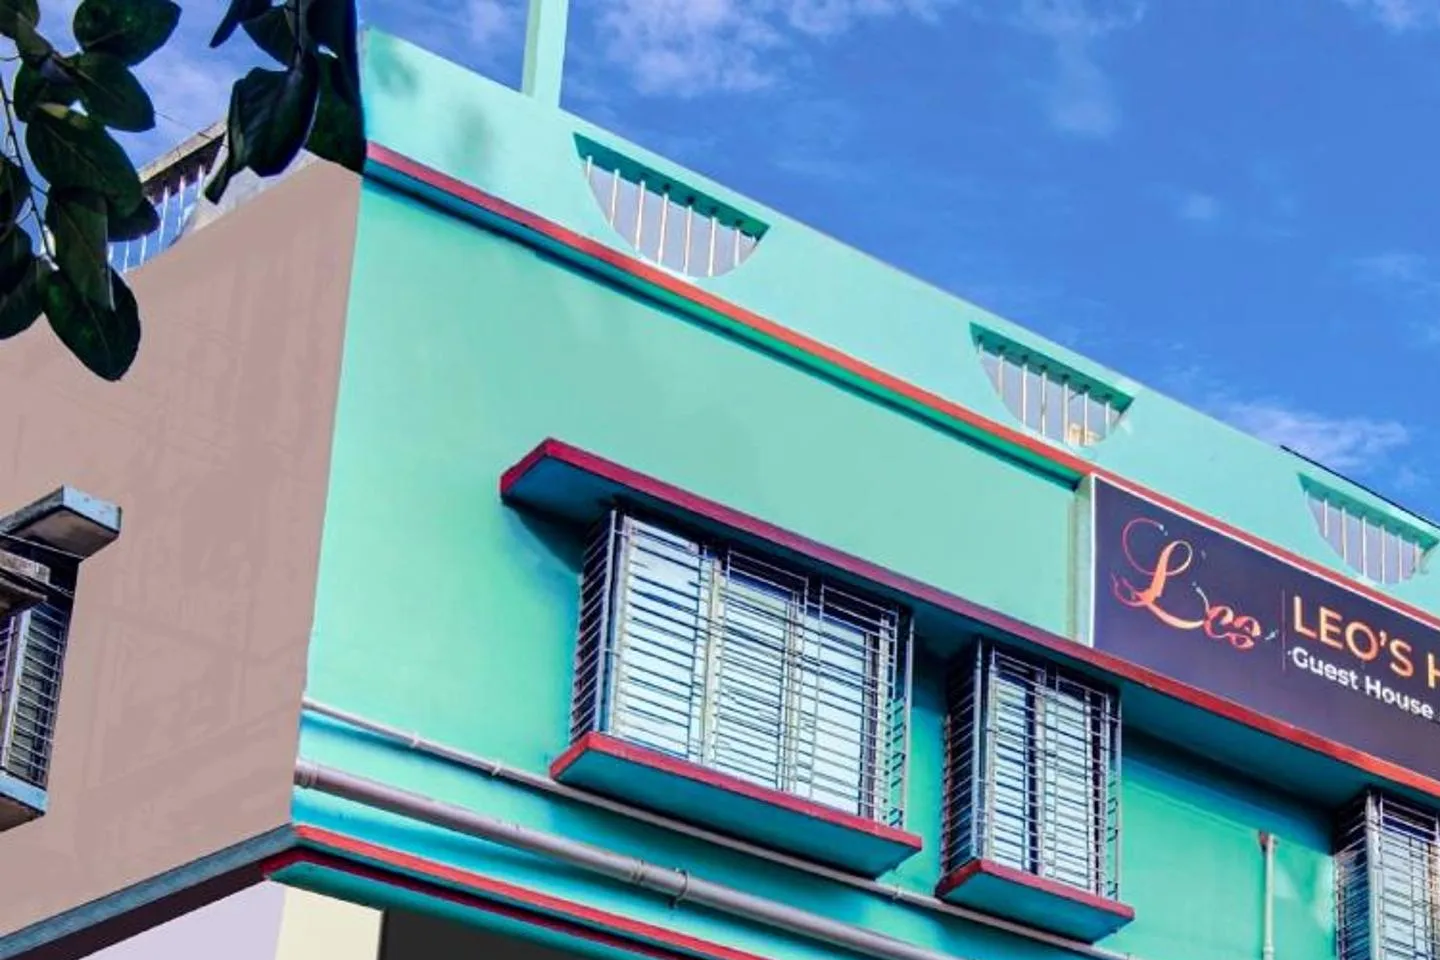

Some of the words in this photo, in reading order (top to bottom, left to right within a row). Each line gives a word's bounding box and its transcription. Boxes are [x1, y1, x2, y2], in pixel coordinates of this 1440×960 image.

[1112, 517, 1262, 651] Leo
[1293, 595, 1414, 678] LEO'S
[1292, 646, 1359, 691] Guest
[1365, 676, 1434, 721] House
